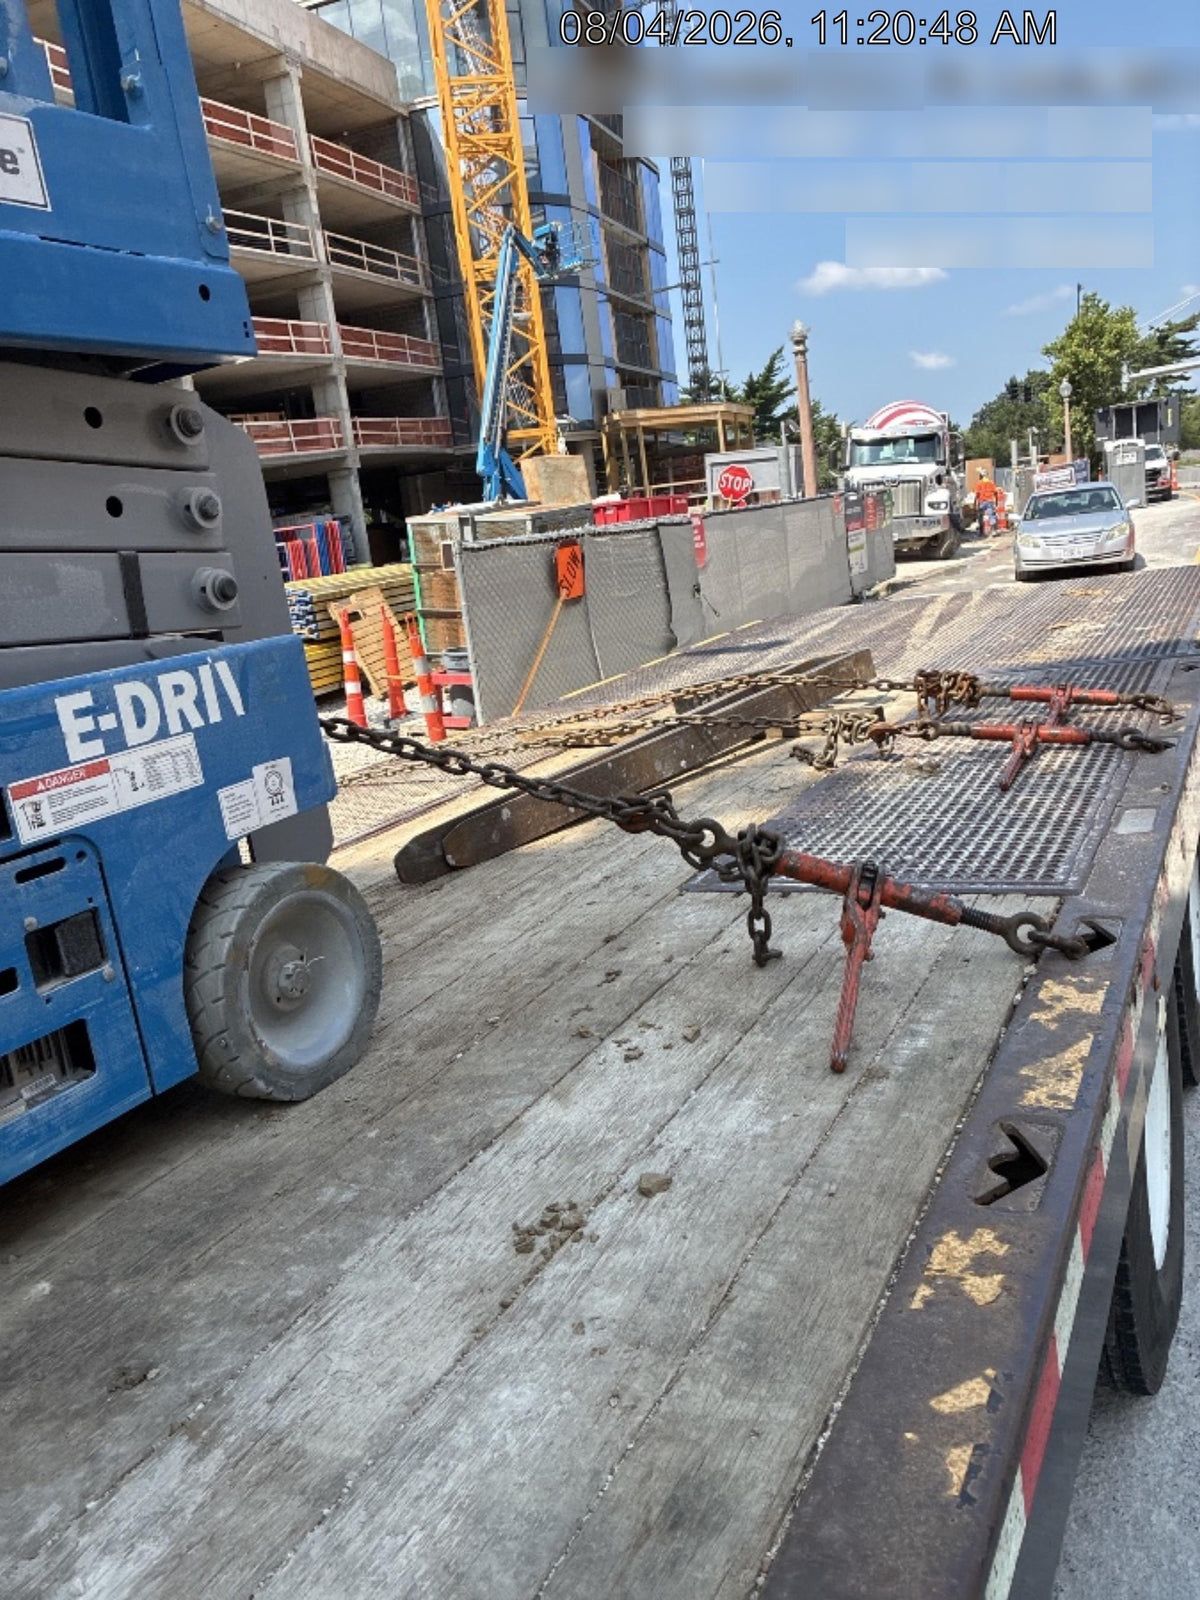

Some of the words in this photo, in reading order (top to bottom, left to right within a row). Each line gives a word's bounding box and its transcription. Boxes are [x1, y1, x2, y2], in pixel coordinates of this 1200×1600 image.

[720, 473, 750, 491] STOP
[559, 547, 580, 598] SLOW
[44, 768, 87, 789] DANGER
